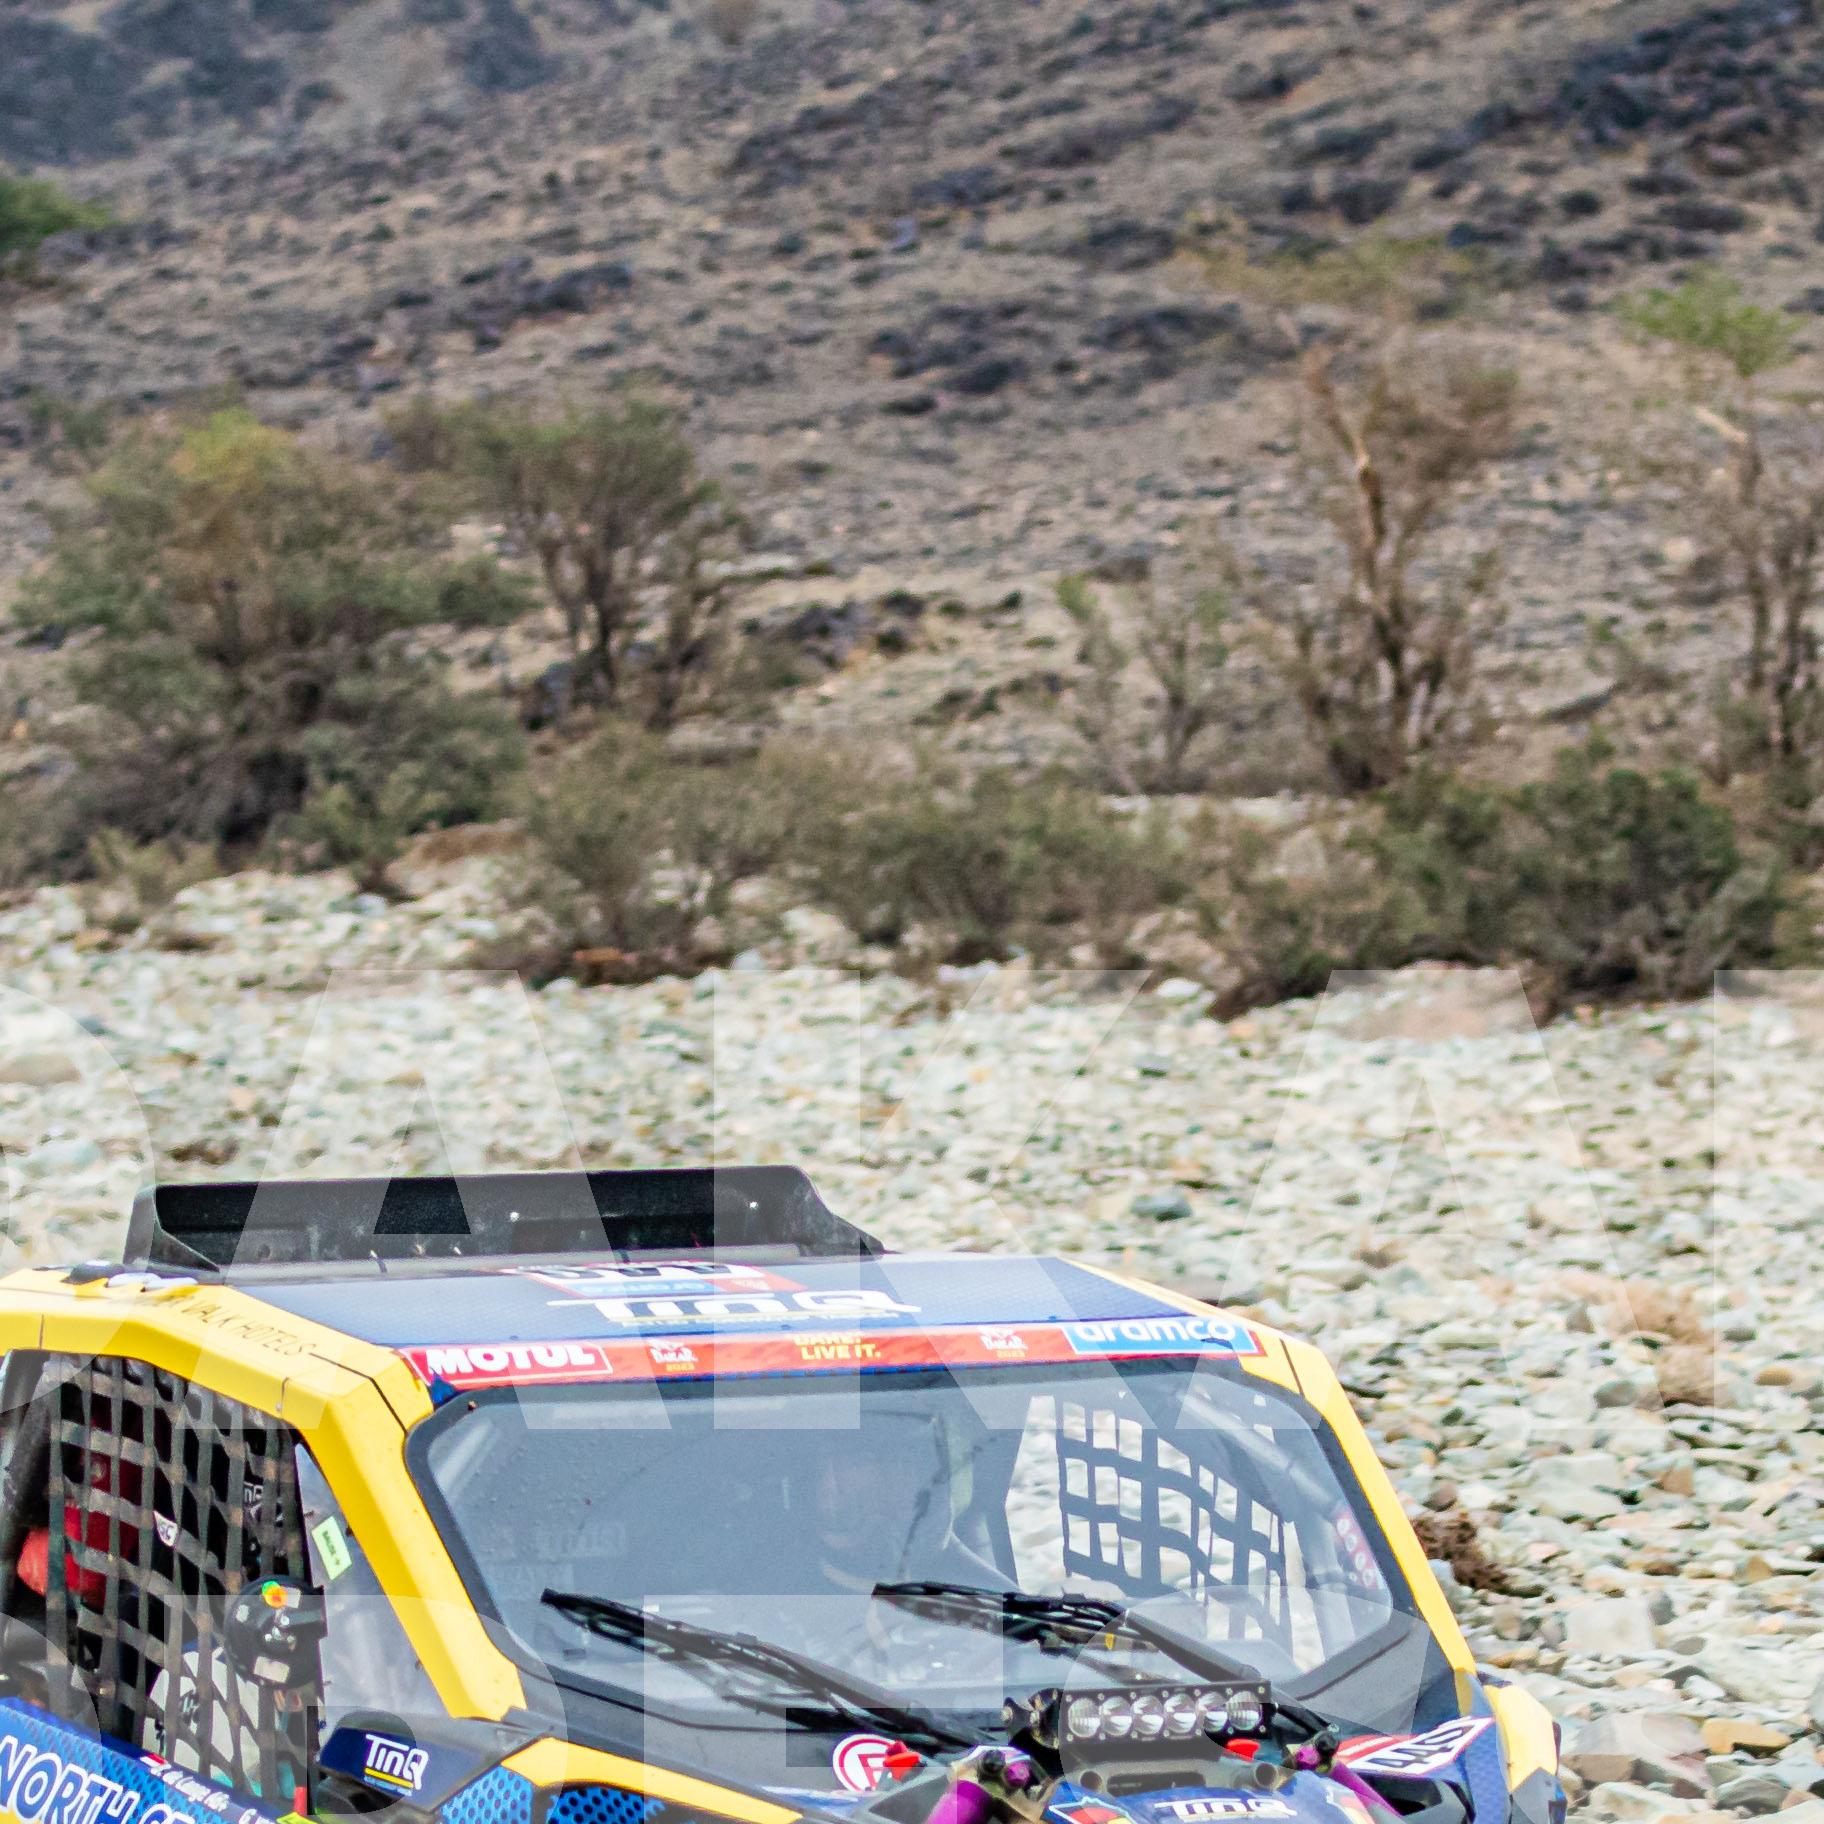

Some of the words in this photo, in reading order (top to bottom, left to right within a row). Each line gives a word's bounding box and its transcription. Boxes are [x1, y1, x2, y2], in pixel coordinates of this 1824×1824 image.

[1075, 1319, 1236, 1342] aramco
[425, 1343, 596, 1375] MOTUL
[801, 1346, 851, 1361] LIVE
